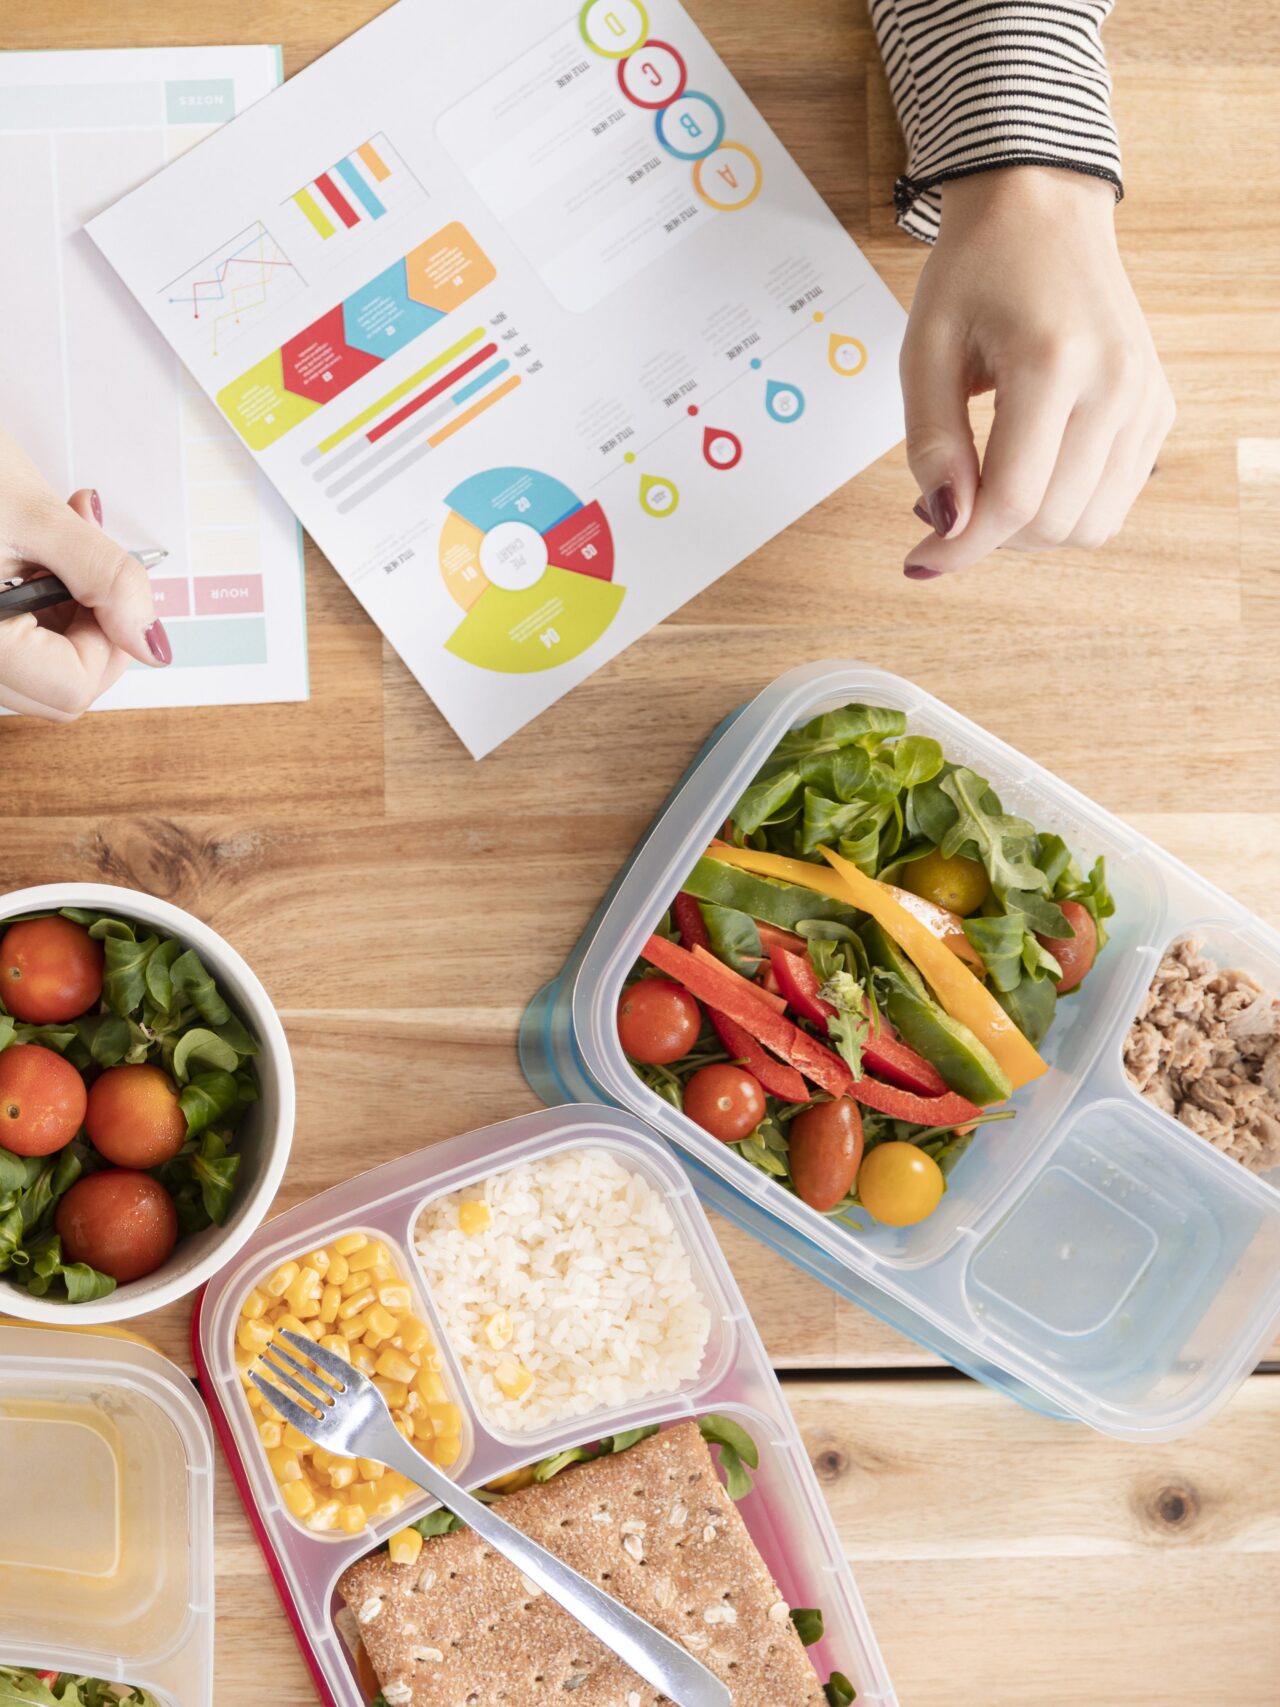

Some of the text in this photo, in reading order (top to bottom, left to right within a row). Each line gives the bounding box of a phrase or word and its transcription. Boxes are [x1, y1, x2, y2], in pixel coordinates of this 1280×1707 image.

[604, 12, 626, 37] D
[555, 60, 590, 88] TITLE HERE
[641, 62, 662, 87] C
[178, 94, 224, 105] NOTES
[591, 108, 626, 136] TITLE HERE
[679, 113, 702, 138] B
[626, 156, 662, 185] TITLE HERE
[716, 164, 738, 189] A
[663, 205, 698, 233] TITLE HERE
[788, 285, 823, 315] TITLE HERE
[726, 332, 760, 360] TITLE HERE
[663, 379, 698, 408] TITLE HERE
[599, 426, 634, 454] TITLE HERE
[514, 496, 531, 512] 02
[382, 549, 415, 574] TITLE HERE
[496, 538, 525, 563] CHART
[509, 553, 527, 570] PIE
[581, 544, 598, 560] 03
[461, 566, 477, 582] 01
[210, 587, 249, 600] HOUR
[539, 627, 560, 649] 04
